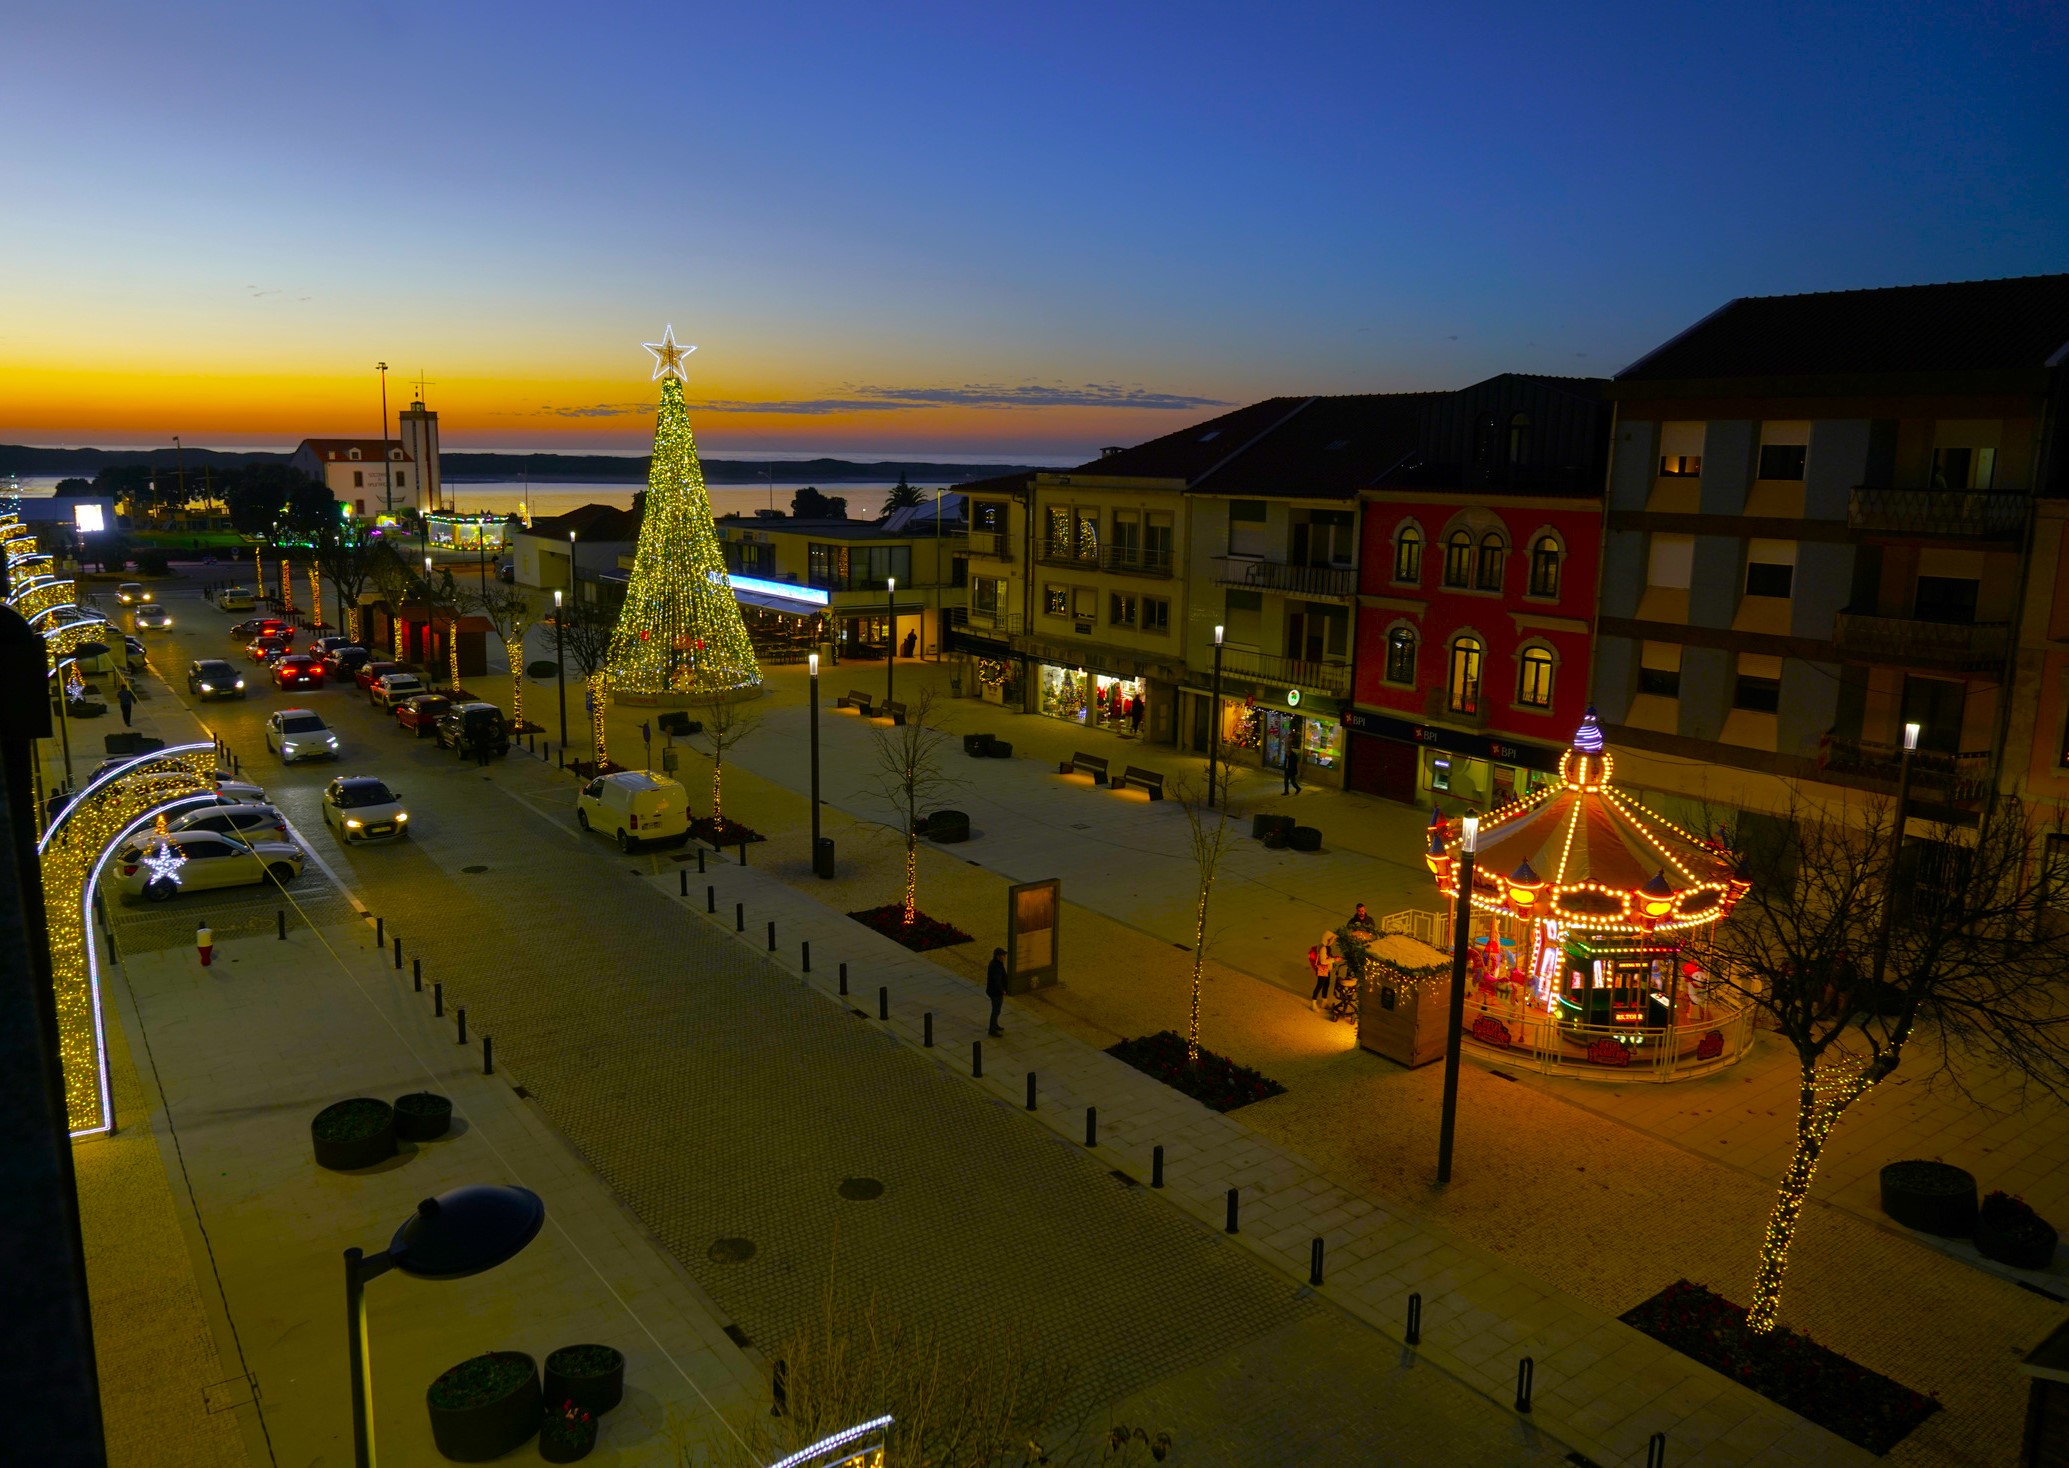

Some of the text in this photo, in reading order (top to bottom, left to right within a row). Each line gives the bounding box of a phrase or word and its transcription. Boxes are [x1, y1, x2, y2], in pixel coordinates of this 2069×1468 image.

[1353, 715, 1366, 727] BPI
[1423, 730, 1438, 742] BPI
[1501, 746, 1517, 759] BPI
